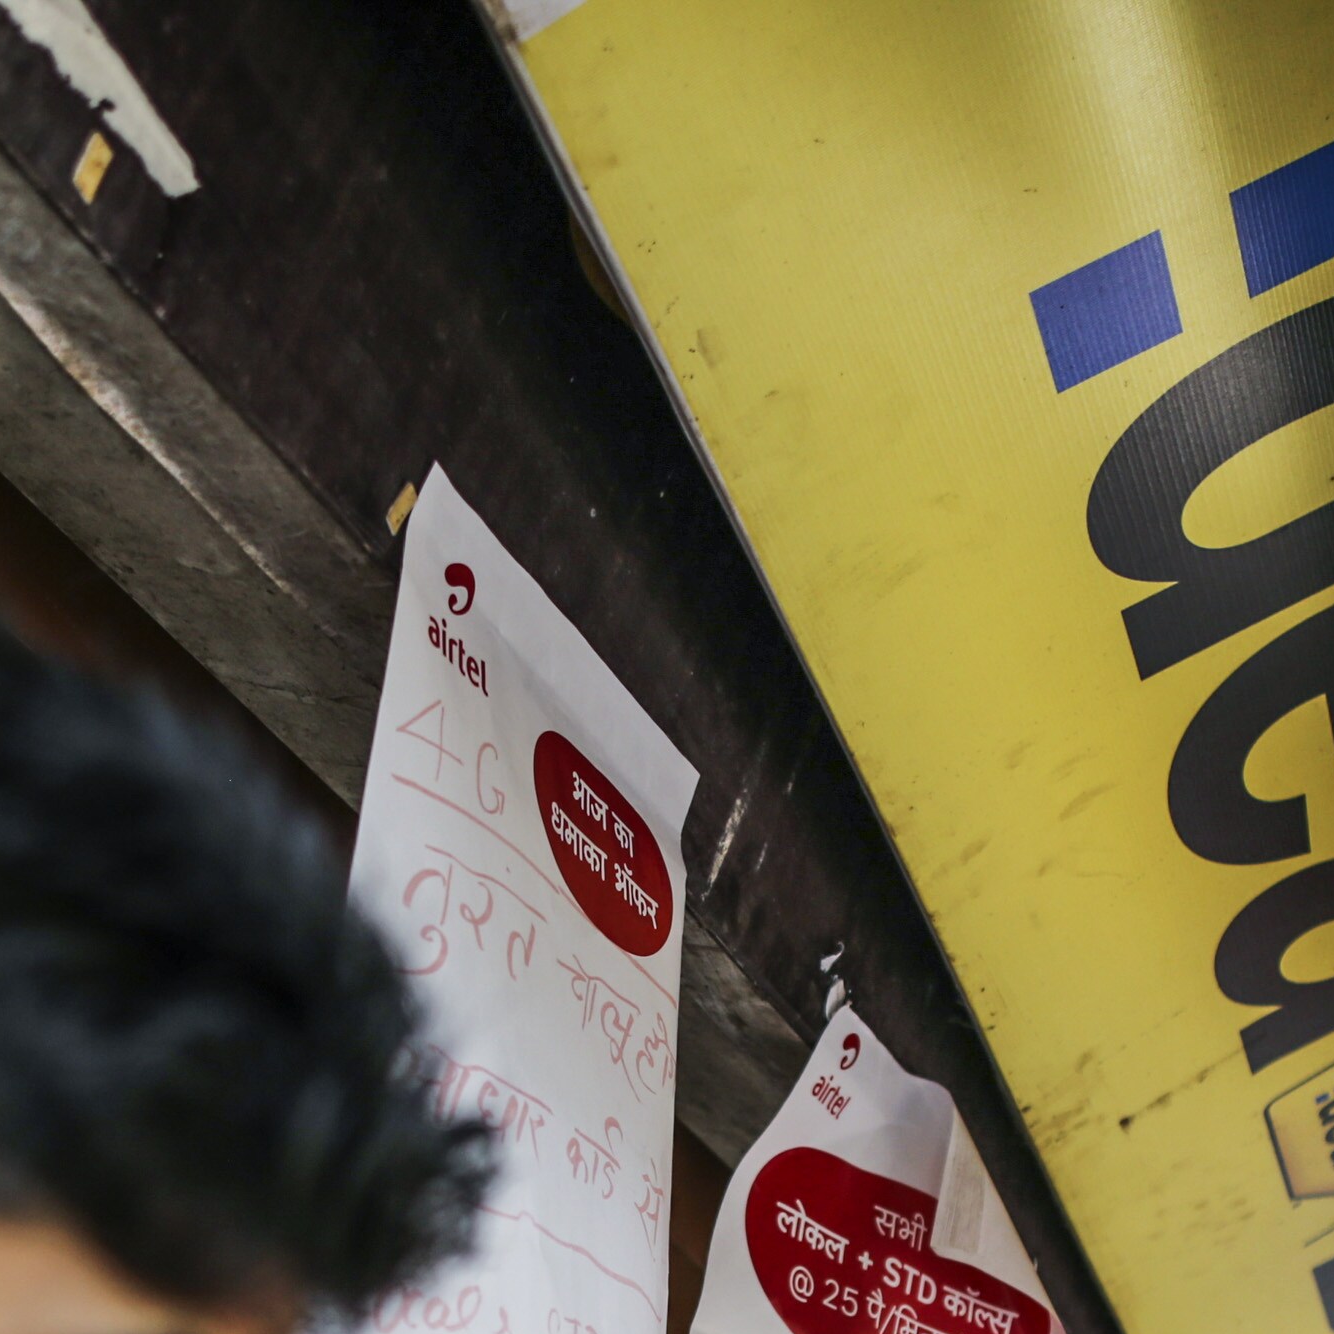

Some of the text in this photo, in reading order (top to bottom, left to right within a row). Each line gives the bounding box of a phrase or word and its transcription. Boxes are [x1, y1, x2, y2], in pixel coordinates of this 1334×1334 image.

[428, 615, 489, 698] airtel
[396, 699, 506, 817] 4G
[571, 770, 635, 858] आज का
[550, 801, 659, 930] धमाका ऑफर
[811, 1074, 852, 1120] airtel
[776, 1198, 850, 1265] लोकल
[857, 1251, 874, 1271] +
[882, 1256, 938, 1306] STD
[873, 1204, 928, 1252] सभी
[788, 1265, 814, 1303] @
[822, 1278, 859, 1318] 25
